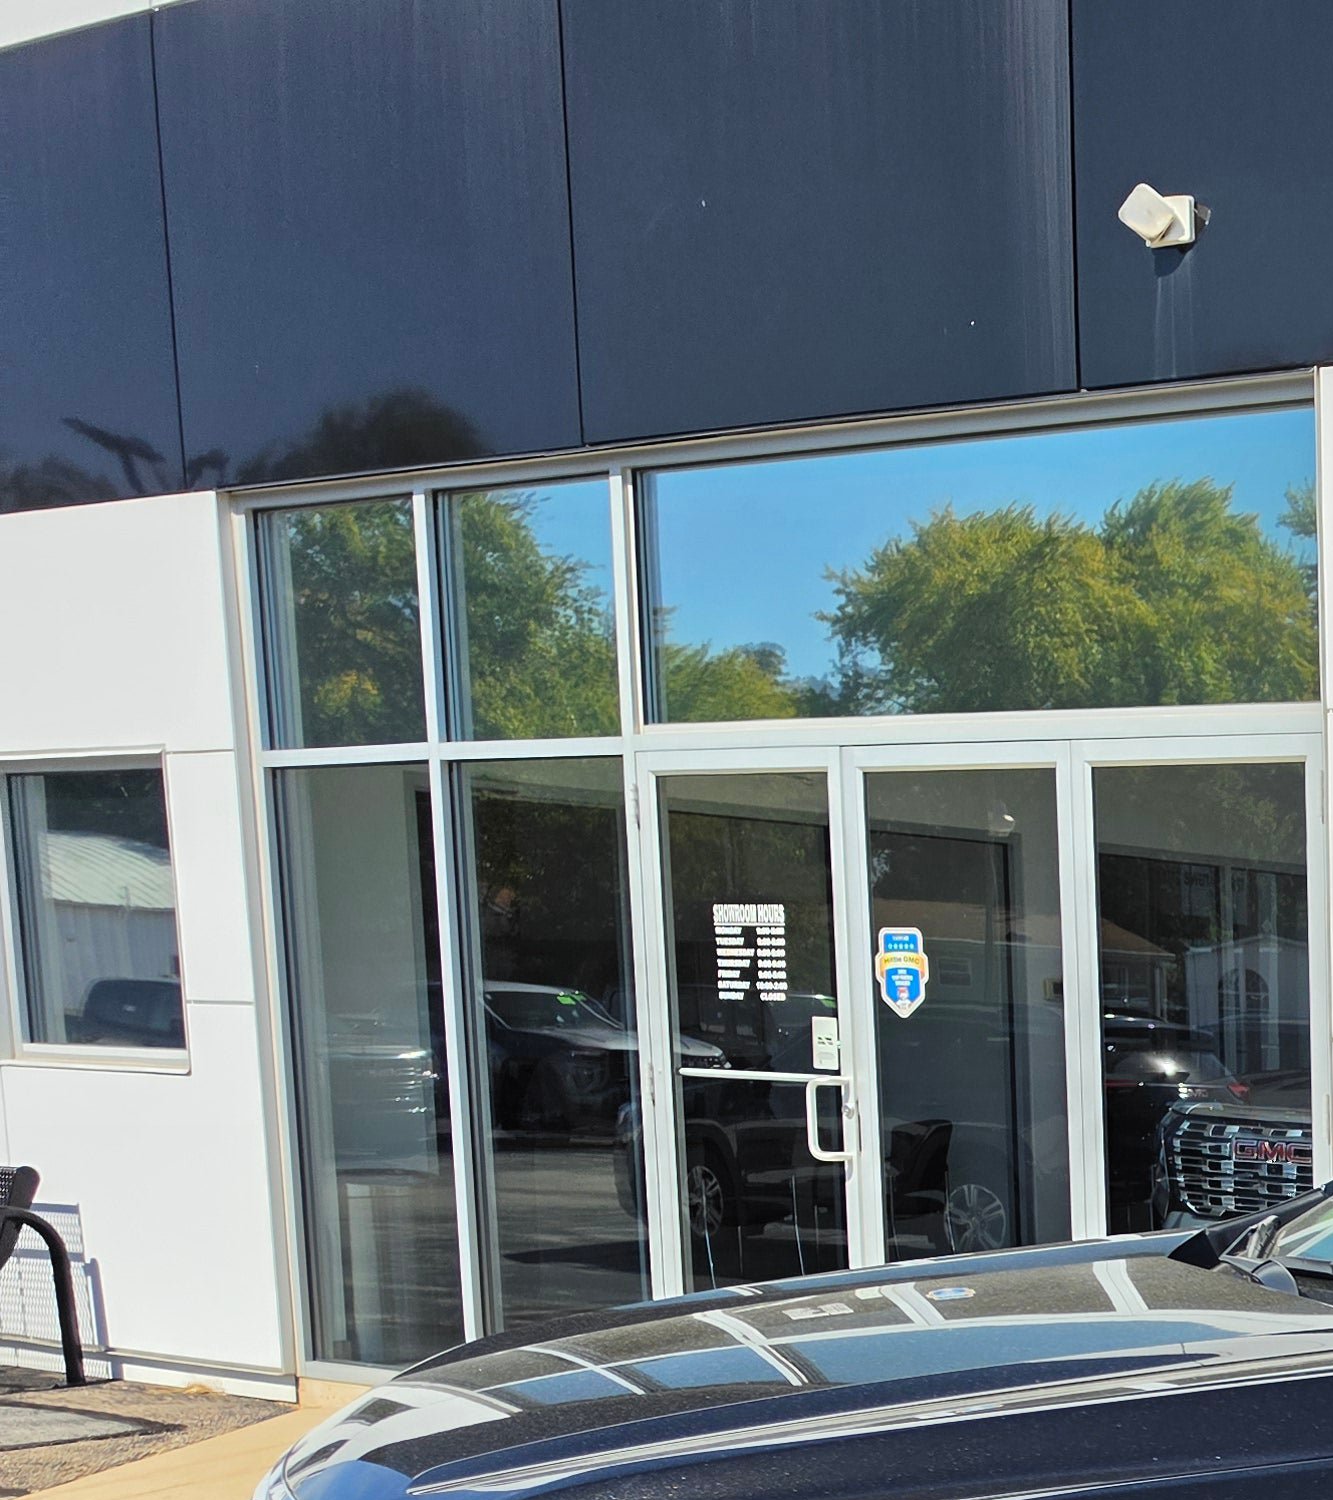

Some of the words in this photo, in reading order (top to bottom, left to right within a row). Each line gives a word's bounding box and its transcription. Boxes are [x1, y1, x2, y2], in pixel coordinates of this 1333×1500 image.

[713, 904, 757, 923] SHOWROOM
[757, 904, 785, 923] HOURS
[1233, 1139, 1312, 1164] GMC
